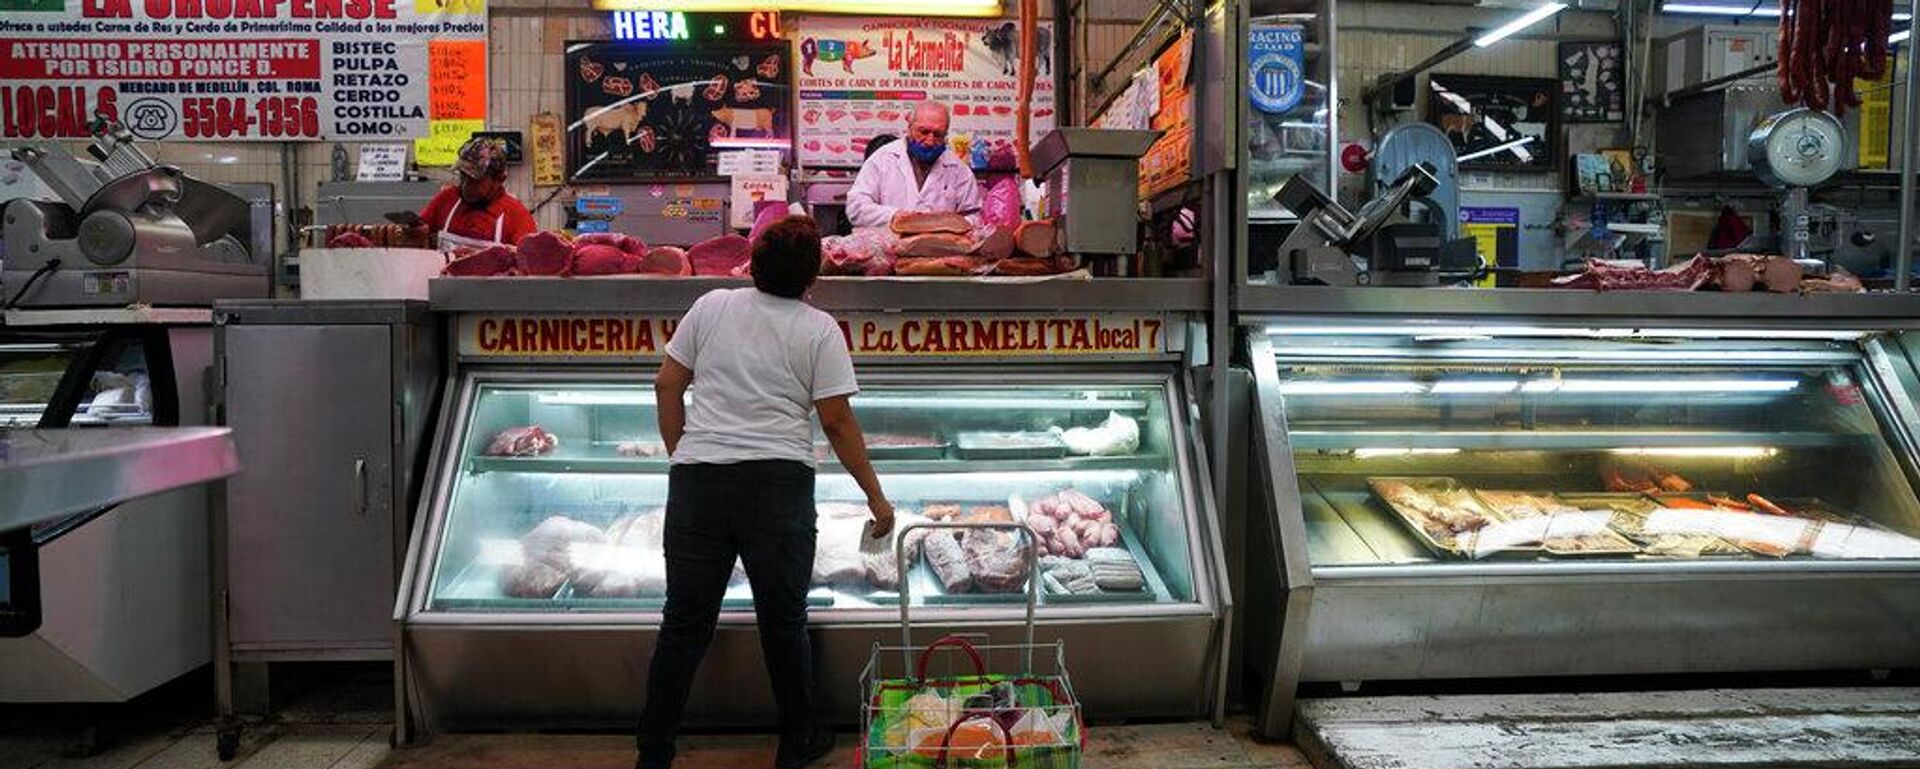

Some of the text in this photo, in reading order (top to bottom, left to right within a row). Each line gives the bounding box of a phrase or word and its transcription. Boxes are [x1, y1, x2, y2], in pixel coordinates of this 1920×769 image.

[96, 21, 131, 32] Carne
[134, 21, 149, 32] de
[152, 22, 172, 32] Res
[175, 25, 183, 34] y
[186, 22, 220, 32] Cerdo
[223, 22, 237, 32] de
[315, 22, 361, 33] Calidad
[376, 23, 392, 33] los
[395, 23, 440, 34] mejores
[443, 22, 484, 33] Precios
[11, 43, 310, 59] ATENDIDO PERSONALMENTE
[332, 42, 396, 54] BISTEC
[45, 59, 277, 76] POR ISIDRO PONCE D.
[333, 58, 399, 71] PULPA
[333, 74, 409, 86] RETAZO
[119, 82, 175, 93] MERCADO
[179, 82, 193, 93] DE
[287, 81, 322, 93] ROMA
[333, 90, 400, 102] CERDO
[2, 86, 92, 138] LOCAL
[182, 96, 319, 138] 5584-1356
[334, 105, 424, 118] COSTILLA
[335, 122, 393, 135] LOMO
[479, 319, 656, 351] CARNICERIA
[860, 321, 898, 351] La
[901, 320, 1093, 352] CARMELITA
[1094, 319, 1140, 350] local
[1143, 320, 1161, 348] 7
